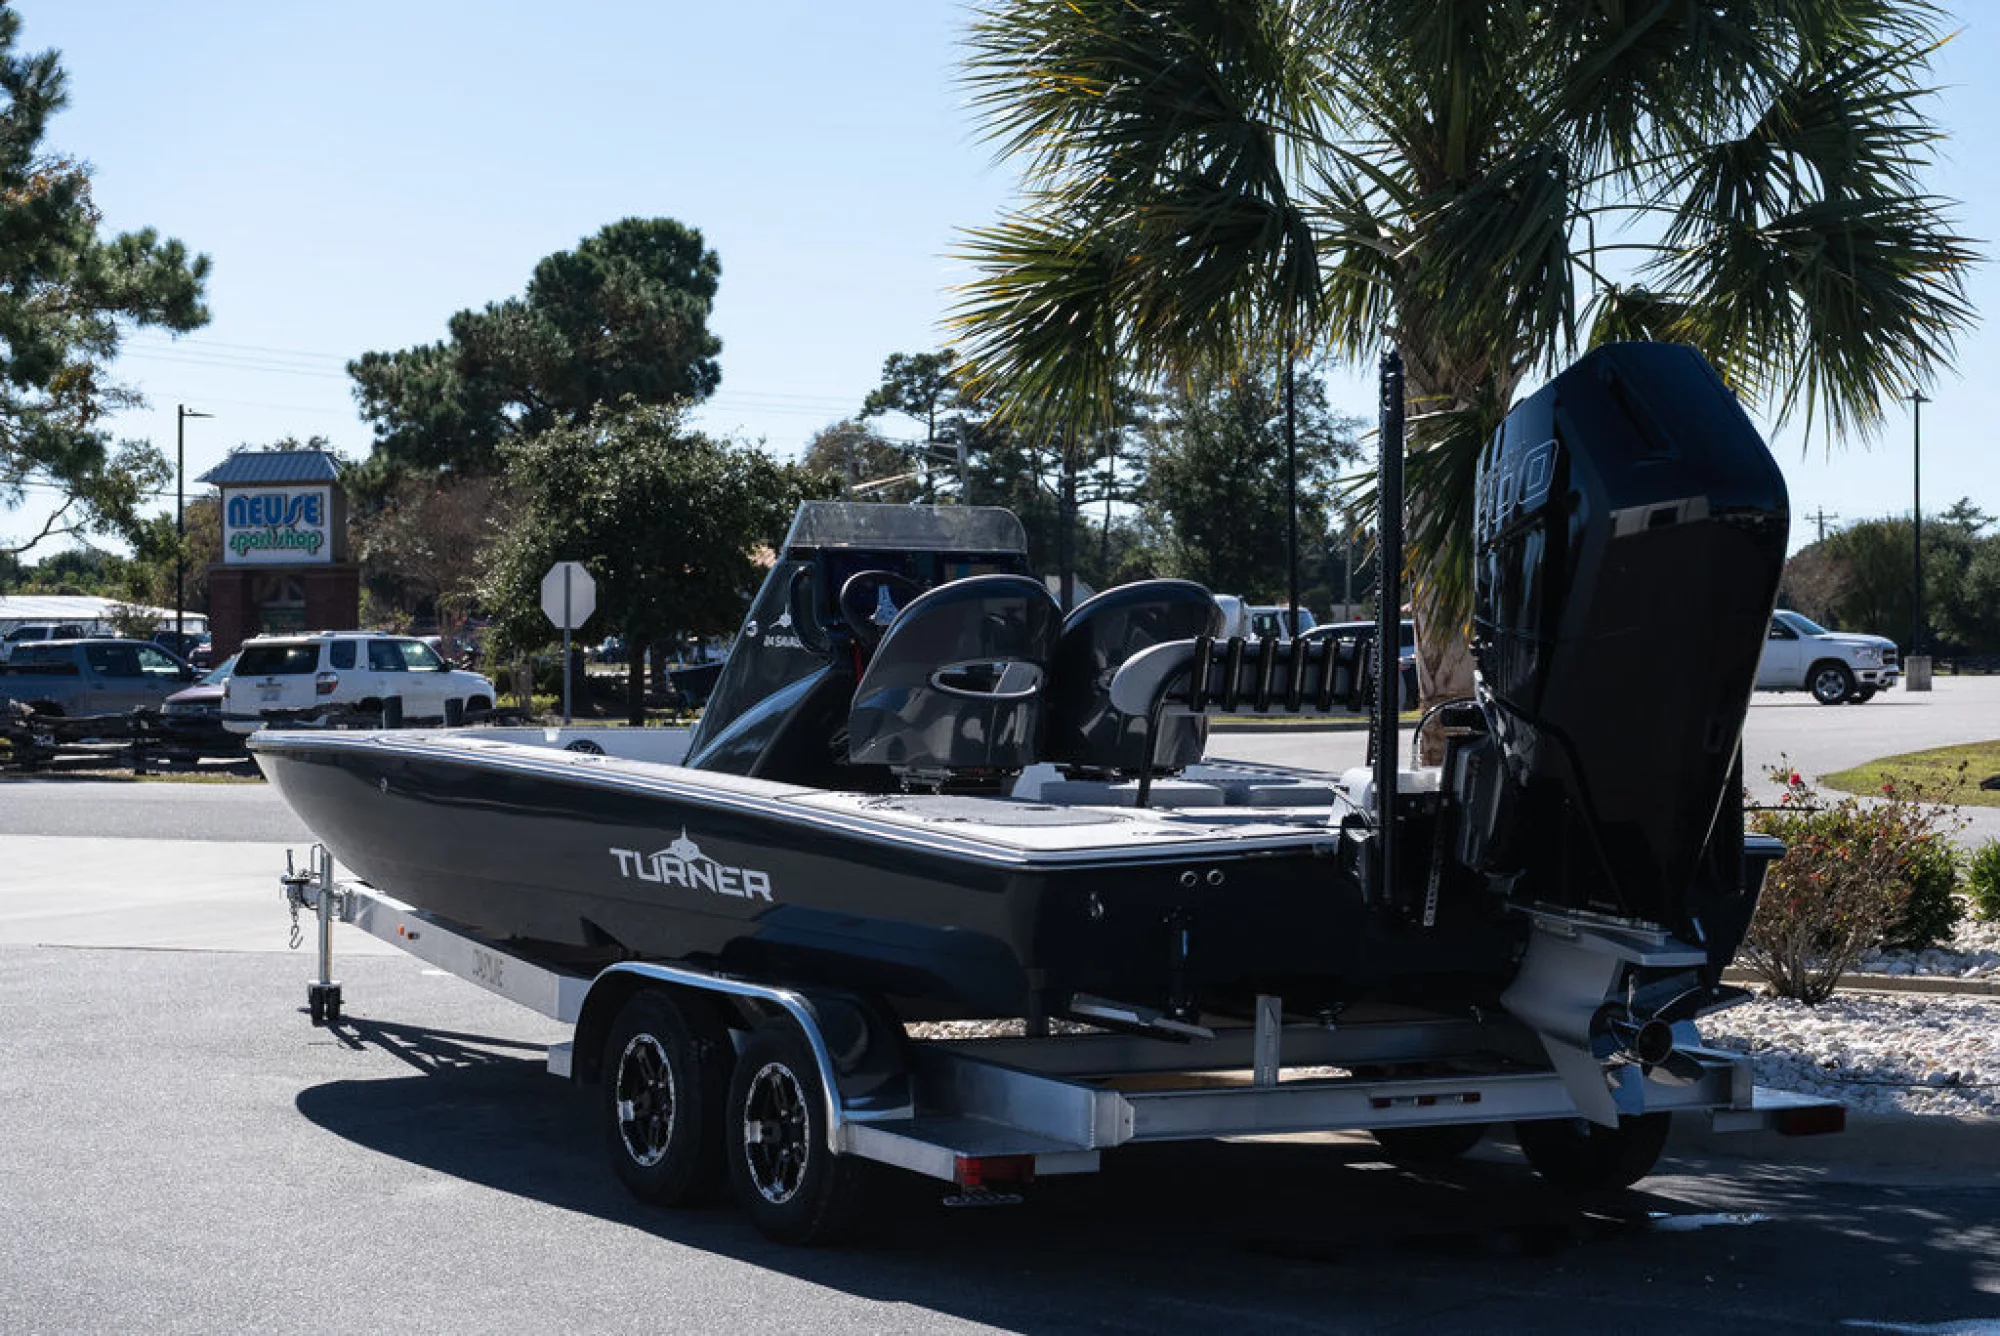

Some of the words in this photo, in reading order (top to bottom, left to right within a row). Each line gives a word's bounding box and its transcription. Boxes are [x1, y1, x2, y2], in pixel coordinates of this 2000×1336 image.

[228, 493, 322, 527] NEUSE
[229, 528, 274, 557] sport
[276, 528, 323, 556] shop
[609, 847, 774, 902] TURNER
